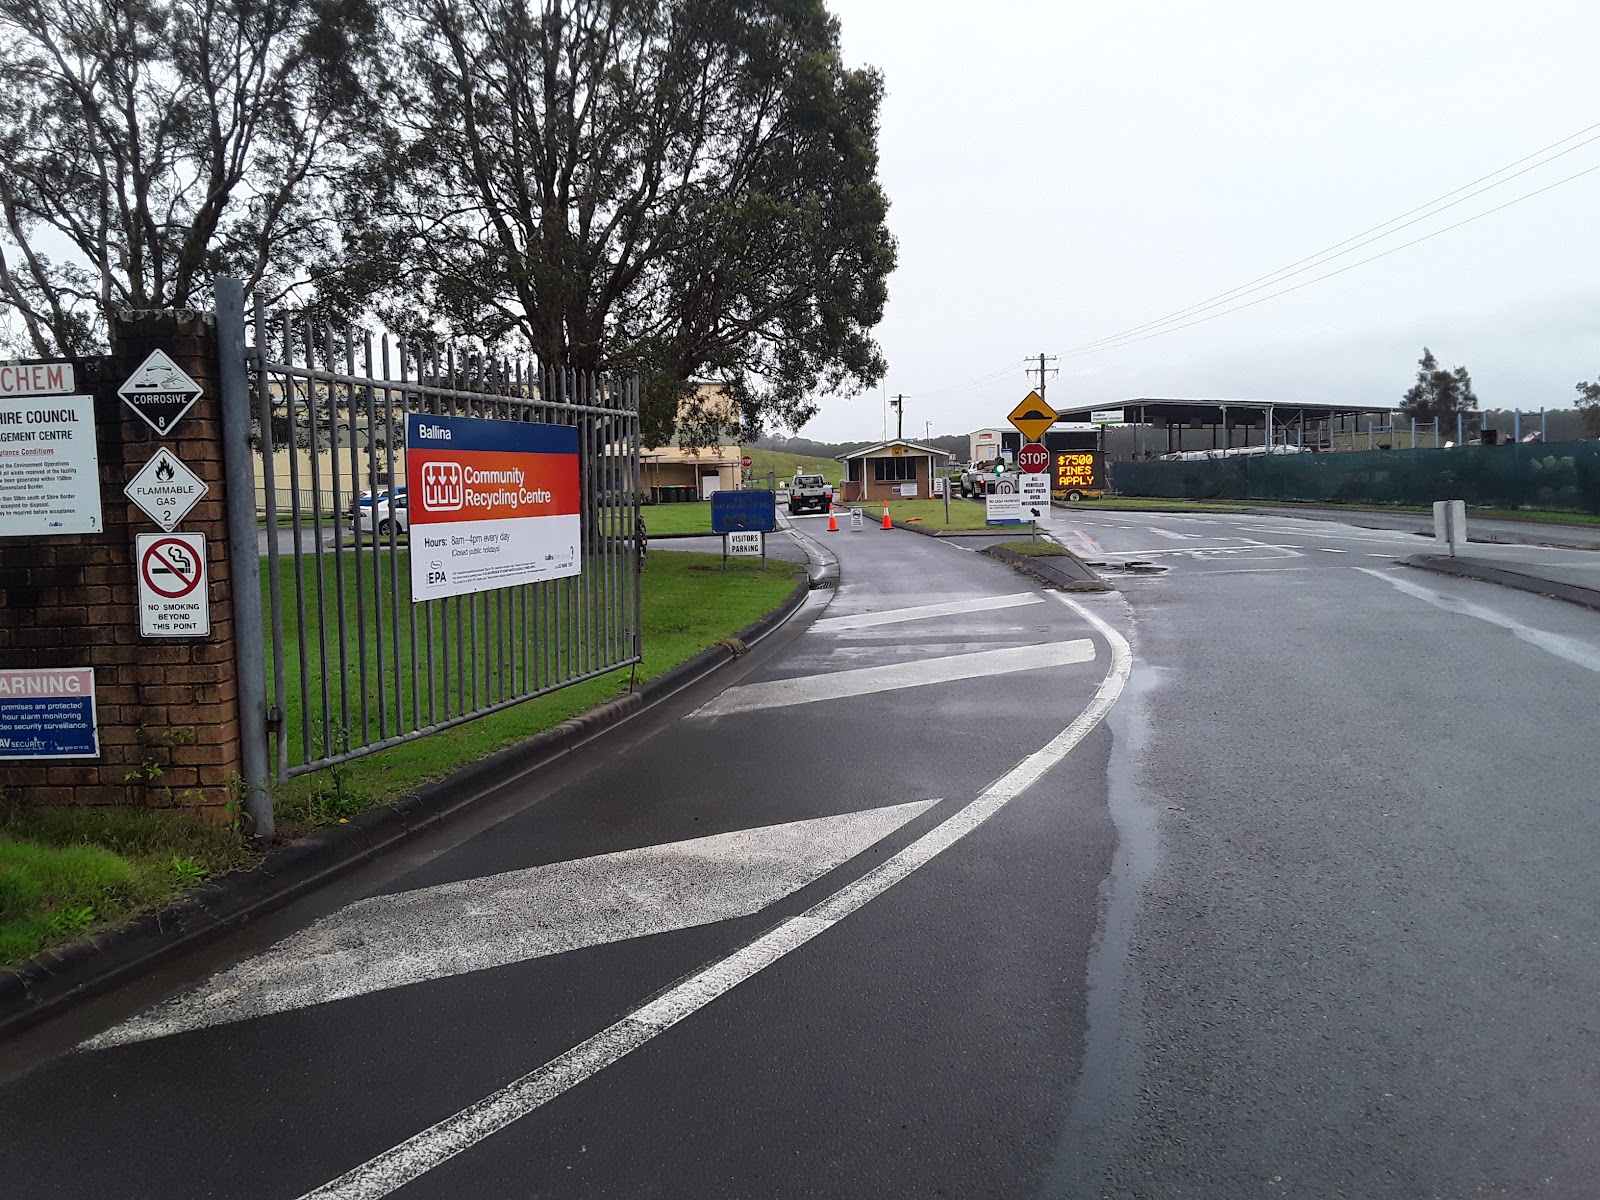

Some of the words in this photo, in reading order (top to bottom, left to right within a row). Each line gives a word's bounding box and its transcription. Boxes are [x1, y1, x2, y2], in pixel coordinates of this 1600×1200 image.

[1, 365, 64, 392] CHEM
[133, 394, 187, 404] CORROSIVE
[26, 409, 79, 424] COUNCIL
[158, 416, 165, 427] 8
[0, 432, 36, 442] GEMENT
[39, 430, 73, 441] CENTRE
[419, 423, 452, 441] Ballina
[1020, 453, 1048, 465] STOP
[1057, 455, 1093, 465] $7500
[1059, 466, 1092, 475] FINES
[464, 465, 525, 488] Community
[1059, 476, 1094, 485] APPLY
[137, 486, 194, 495] FLAMMABLE
[1000, 485, 1010, 494] 10
[156, 497, 176, 506] GAS
[465, 489, 518, 510] Recycling
[518, 487, 551, 504] Centre
[163, 510, 172, 521] 2
[424, 537, 448, 548] Hours:
[484, 533, 500, 545] every
[500, 531, 510, 543] day
[469, 547, 482, 556] public
[428, 571, 447, 584] EPA
[47, 702, 83, 711] protected
[14, 723, 42, 731] security
[44, 722, 86, 730] surveillance
